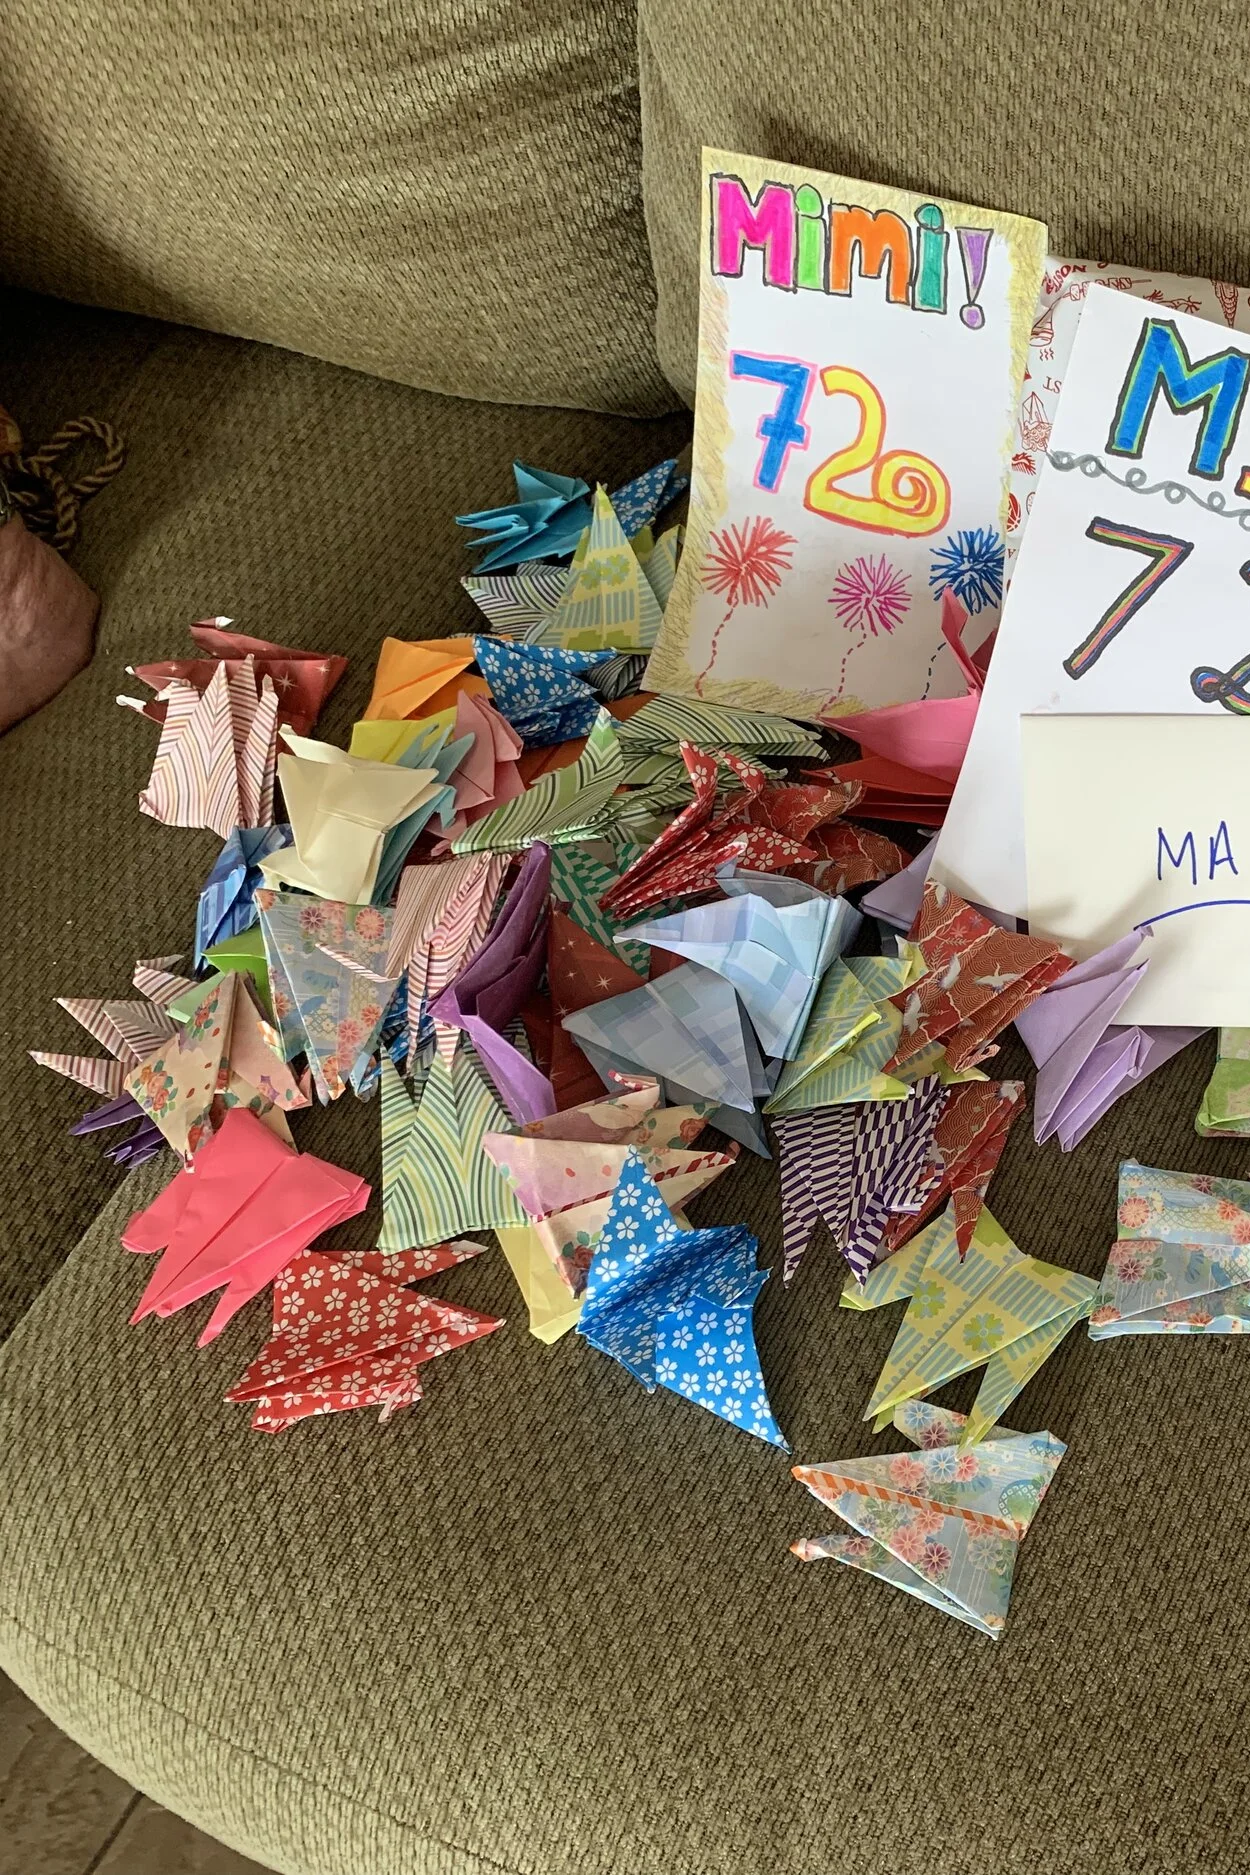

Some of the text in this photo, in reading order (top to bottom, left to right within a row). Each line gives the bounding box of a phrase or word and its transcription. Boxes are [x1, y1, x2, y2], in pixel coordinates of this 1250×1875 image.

[710, 173, 995, 330] Mimi!
[729, 350, 951, 538] 72
[1157, 820, 1239, 885] MA
